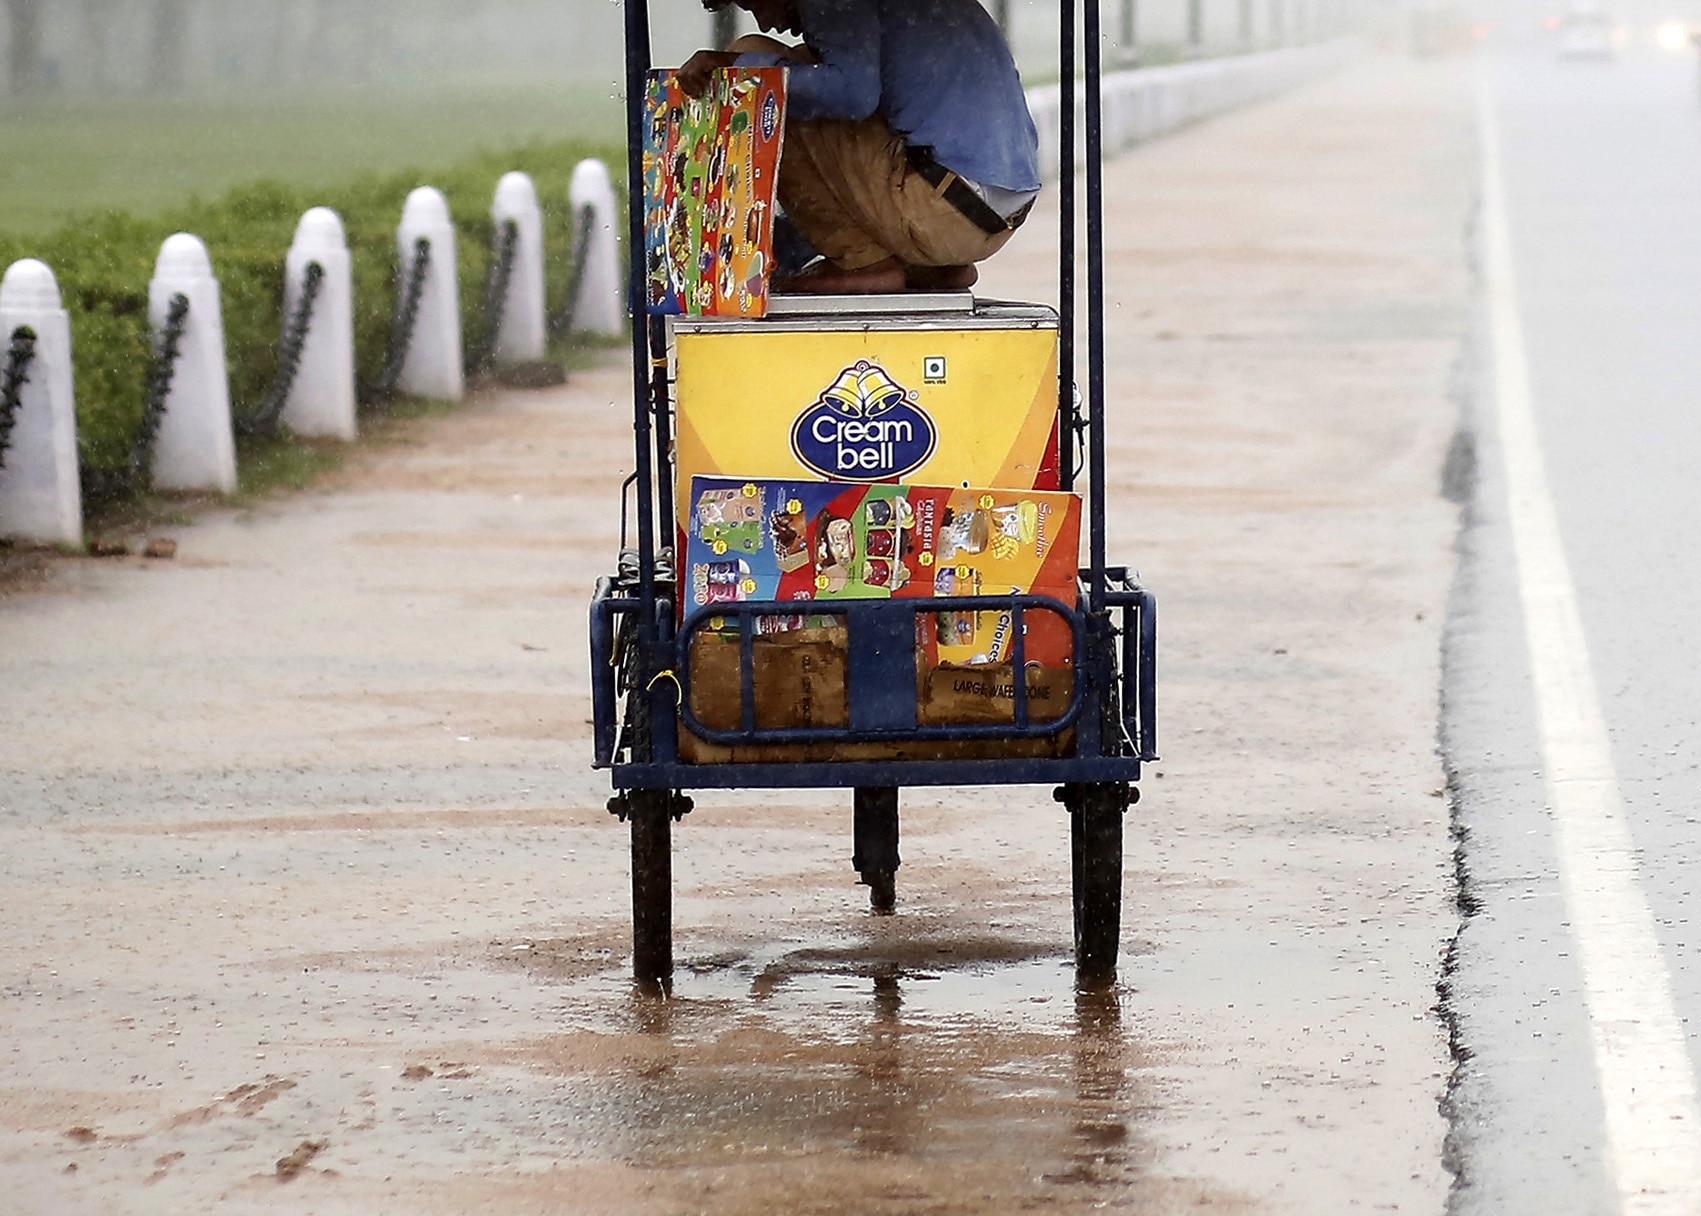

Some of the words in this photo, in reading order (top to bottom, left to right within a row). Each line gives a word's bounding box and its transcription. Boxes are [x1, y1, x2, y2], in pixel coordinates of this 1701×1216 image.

[811, 415, 913, 445] Cream
[836, 442, 894, 471] bell
[1036, 501, 1053, 558] Smoothie
[953, 680, 987, 697] LARGE
